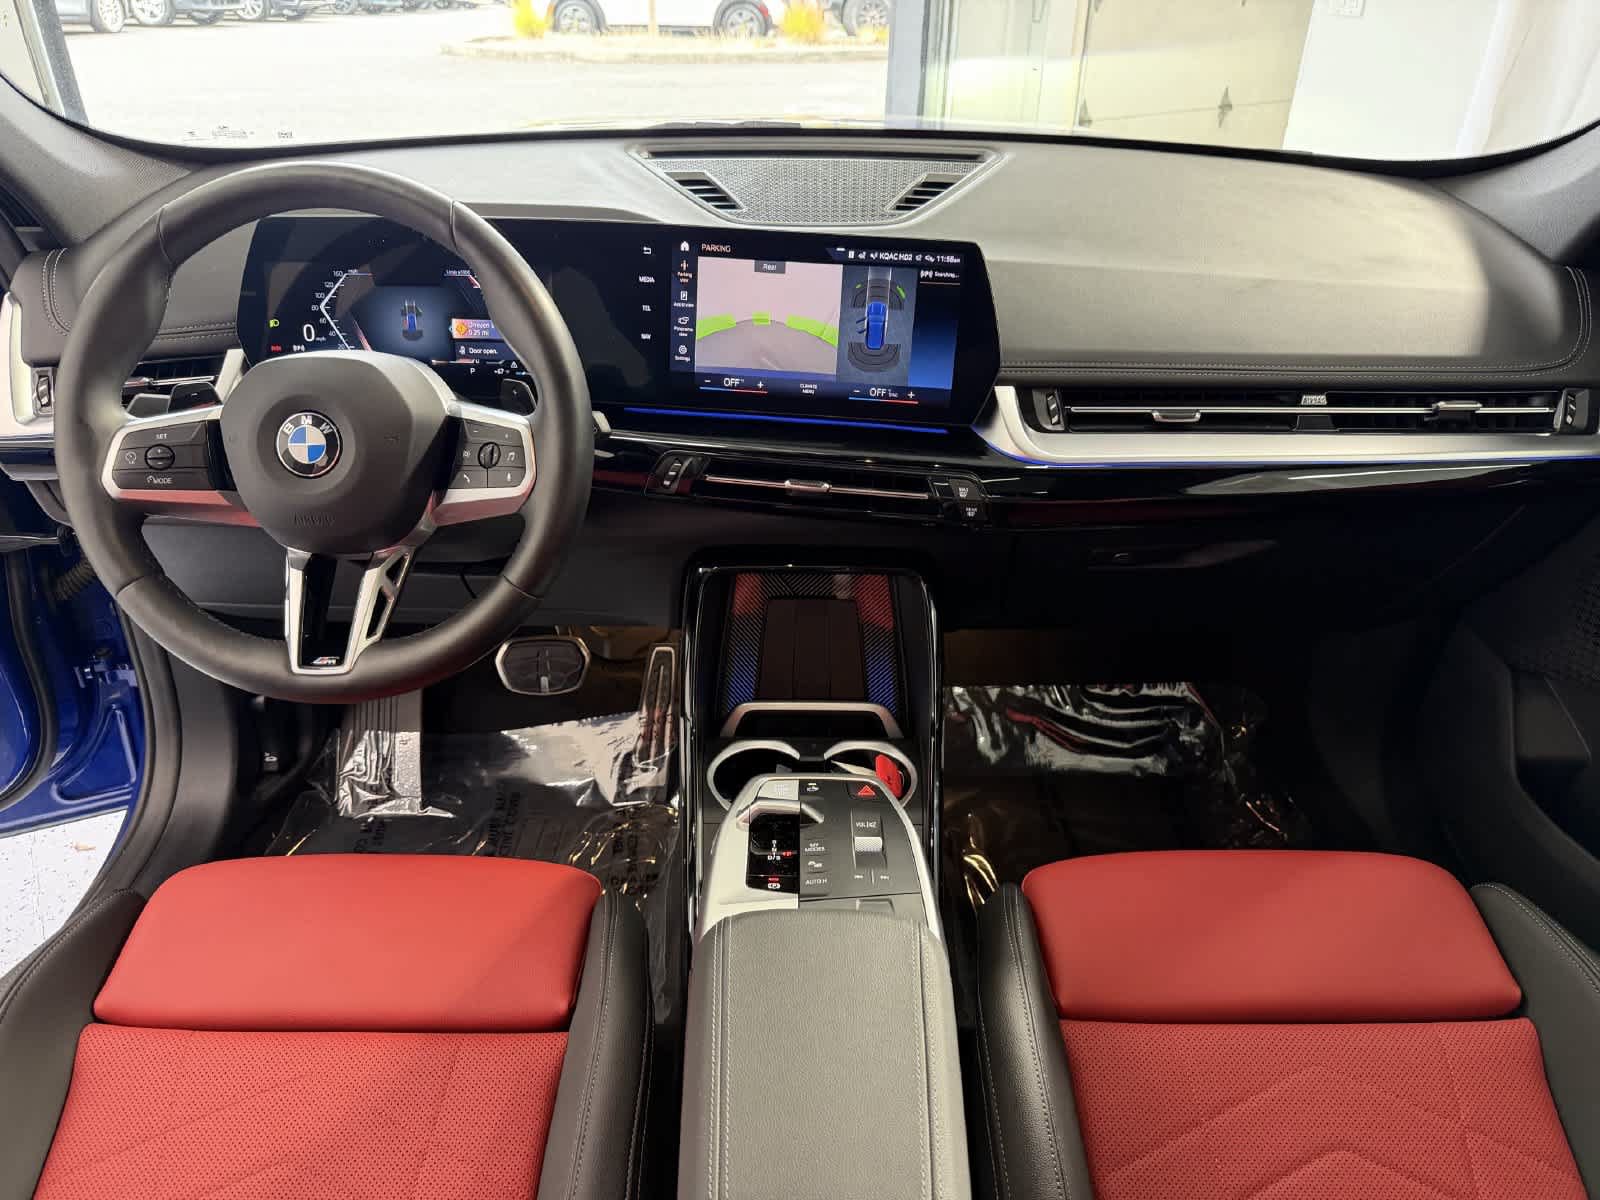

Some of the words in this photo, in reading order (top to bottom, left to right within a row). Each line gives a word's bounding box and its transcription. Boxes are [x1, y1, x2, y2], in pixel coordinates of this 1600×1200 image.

[701, 243, 732, 253] PARKING
[639, 275, 655, 283] MEDIA
[642, 304, 652, 312] TEL
[303, 323, 315, 342] 0
[723, 377, 741, 387] OFF
[869, 387, 887, 397] OFF
[283, 415, 333, 435] BMW
[153, 476, 173, 485] MODE
